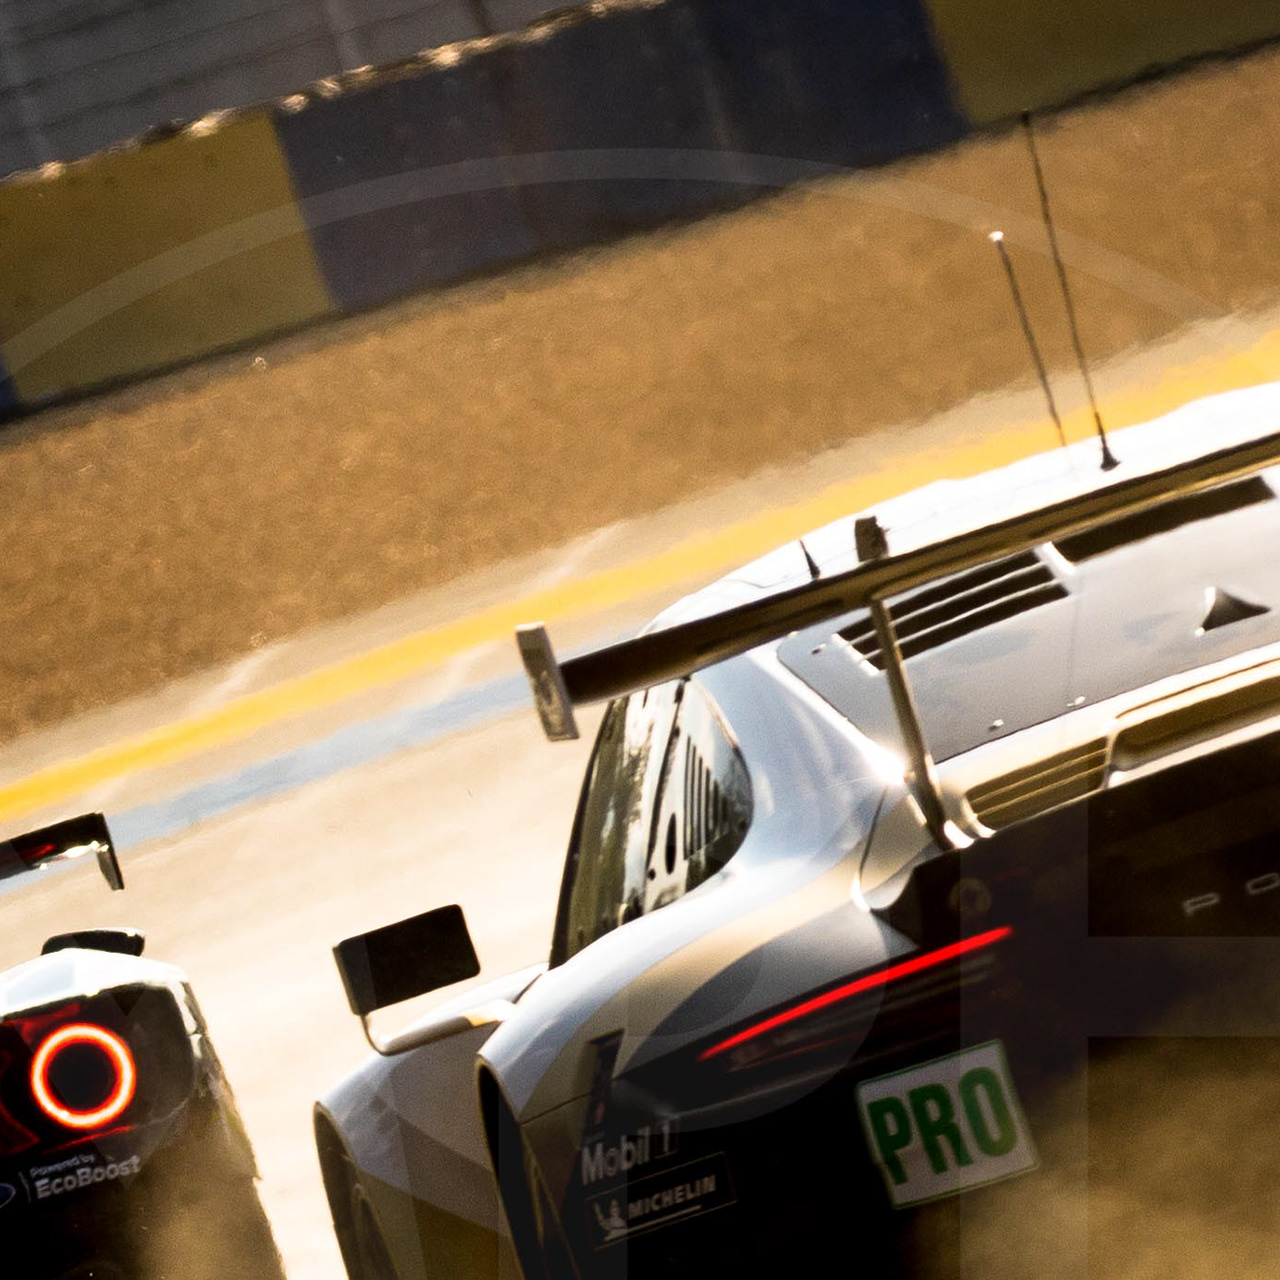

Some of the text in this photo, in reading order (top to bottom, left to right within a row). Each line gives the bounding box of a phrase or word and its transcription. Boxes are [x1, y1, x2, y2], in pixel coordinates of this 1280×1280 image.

[867, 1067, 1015, 1186] PRO
[30, 1157, 79, 1179] Powered
[35, 1155, 141, 1200] EcoBoost
[581, 1125, 651, 1185] Mobil
[628, 1174, 717, 1218] MICHELIN
